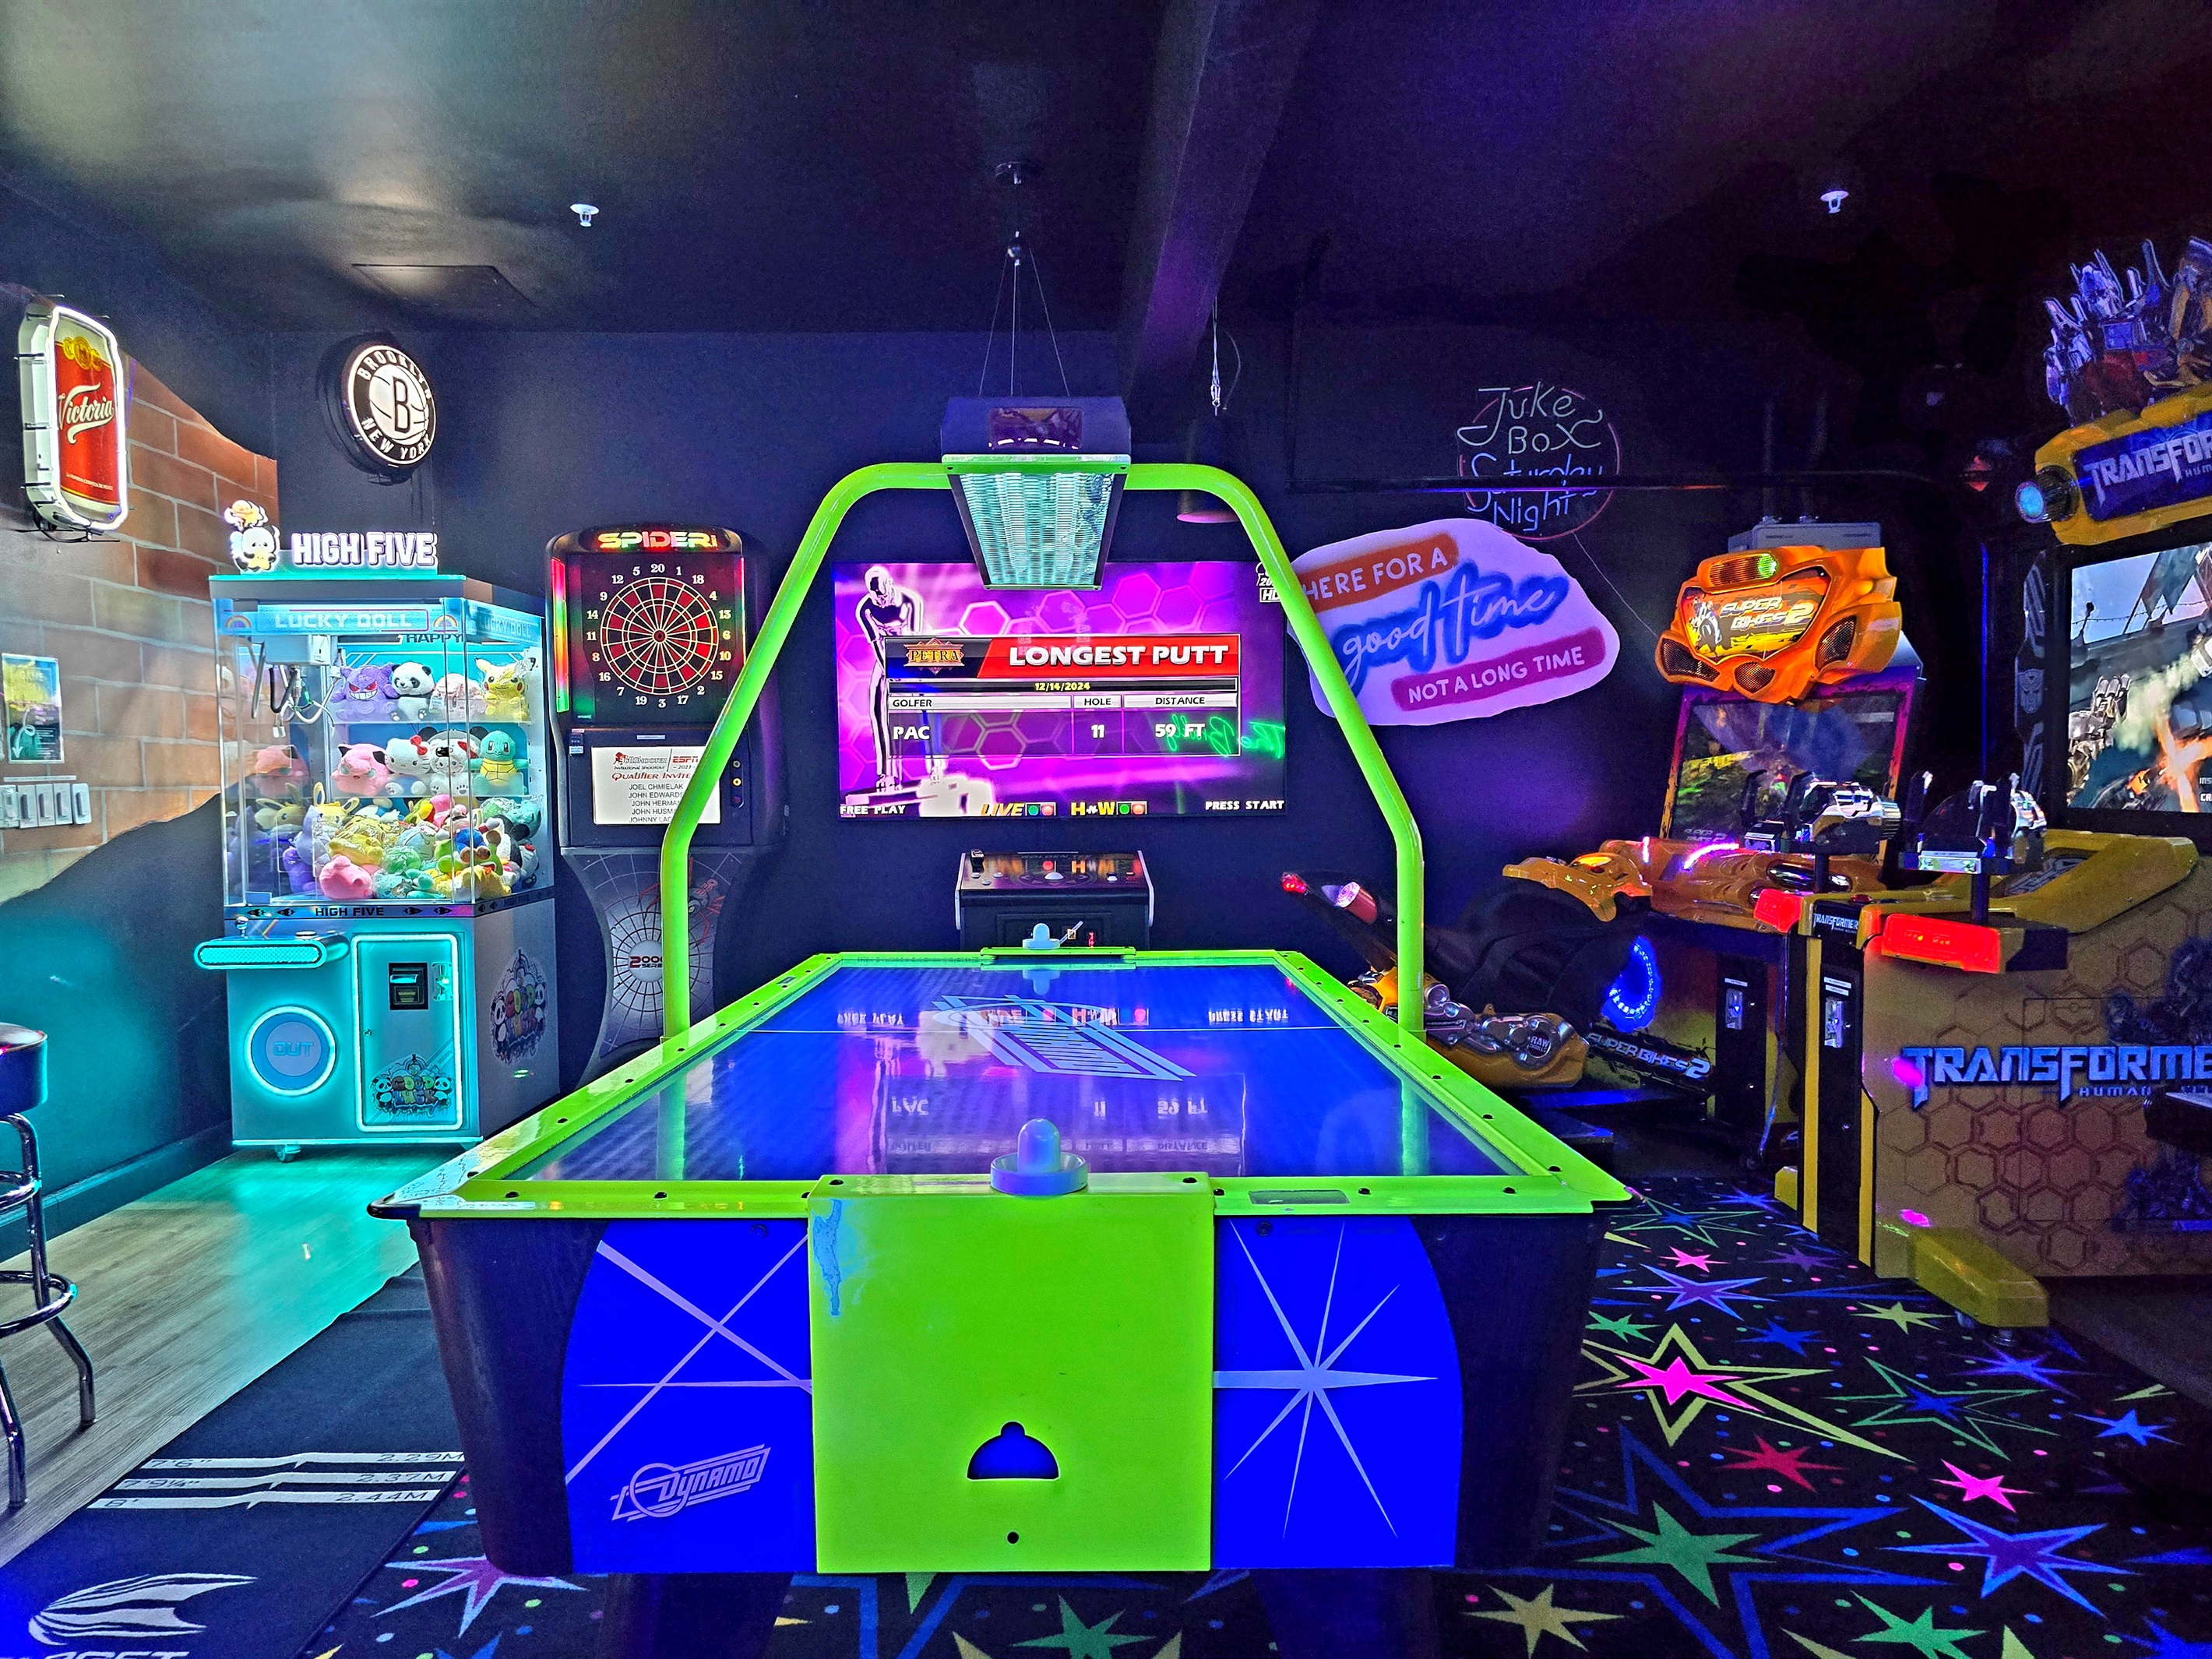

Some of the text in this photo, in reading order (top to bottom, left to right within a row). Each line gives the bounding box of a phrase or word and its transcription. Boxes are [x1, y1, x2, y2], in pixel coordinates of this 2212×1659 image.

[357, 350, 432, 399] BROOKLYN
[58, 381, 115, 442] Victoria
[1456, 382, 1576, 446] Juke
[361, 417, 431, 460] NEW YORK
[1493, 490, 1577, 532] Night
[291, 531, 439, 566] HIGH FIVE
[632, 566, 640, 576] 5
[651, 564, 665, 573] 20
[676, 566, 682, 576] 1
[1300, 547, 1448, 601] HERE FOR A
[611, 575, 624, 584] 12
[692, 575, 705, 584] 18
[600, 592, 608, 601] 9
[709, 591, 717, 601] 4
[1719, 596, 1783, 618] SUPER
[586, 610, 599, 619] 14
[719, 610, 731, 619] 13
[1730, 602, 1815, 631] BIKES 2
[275, 612, 413, 629] LUCKY DOLL
[586, 632, 597, 641] 11
[722, 631, 731, 640] 6
[1342, 574, 1556, 689] good time
[406, 634, 464, 643] HAPPY
[592, 652, 601, 661] 8
[719, 651, 731, 660] 10
[910, 650, 960, 663] PETRA
[1009, 645, 1229, 667] LONGEST PUTT
[598, 672, 611, 682] 16
[710, 671, 723, 680] 15
[1407, 645, 1585, 703] NOT A LONG TIME
[617, 687, 625, 696] 7
[697, 686, 705, 696] 2
[1034, 682, 1091, 692] 12/14/2024
[635, 696, 647, 705] 19
[658, 699, 666, 708] 3
[677, 696, 689, 705] 17
[893, 696, 1206, 708] GOLFER HOLE DISTANCE
[893, 723, 1206, 741] PAC 11 59 FT
[840, 805, 907, 815] FREE PLAY
[981, 802, 1025, 816] LIVE
[1205, 799, 1285, 812] PRESS START
[315, 907, 384, 917] HIGH FIVE
[1813, 913, 1859, 931] TRANSFORMER
[1530, 1035, 1550, 1048] RAW
[273, 1041, 314, 1057] OUT
[1584, 1032, 1711, 1080] SUPER BIKES 2
[377, 1453, 464, 1462] 2.29M
[355, 1472, 446, 1482] 2.37M
[657, 1460, 760, 1503] Dynamo
[335, 1491, 429, 1502] 2.44M
